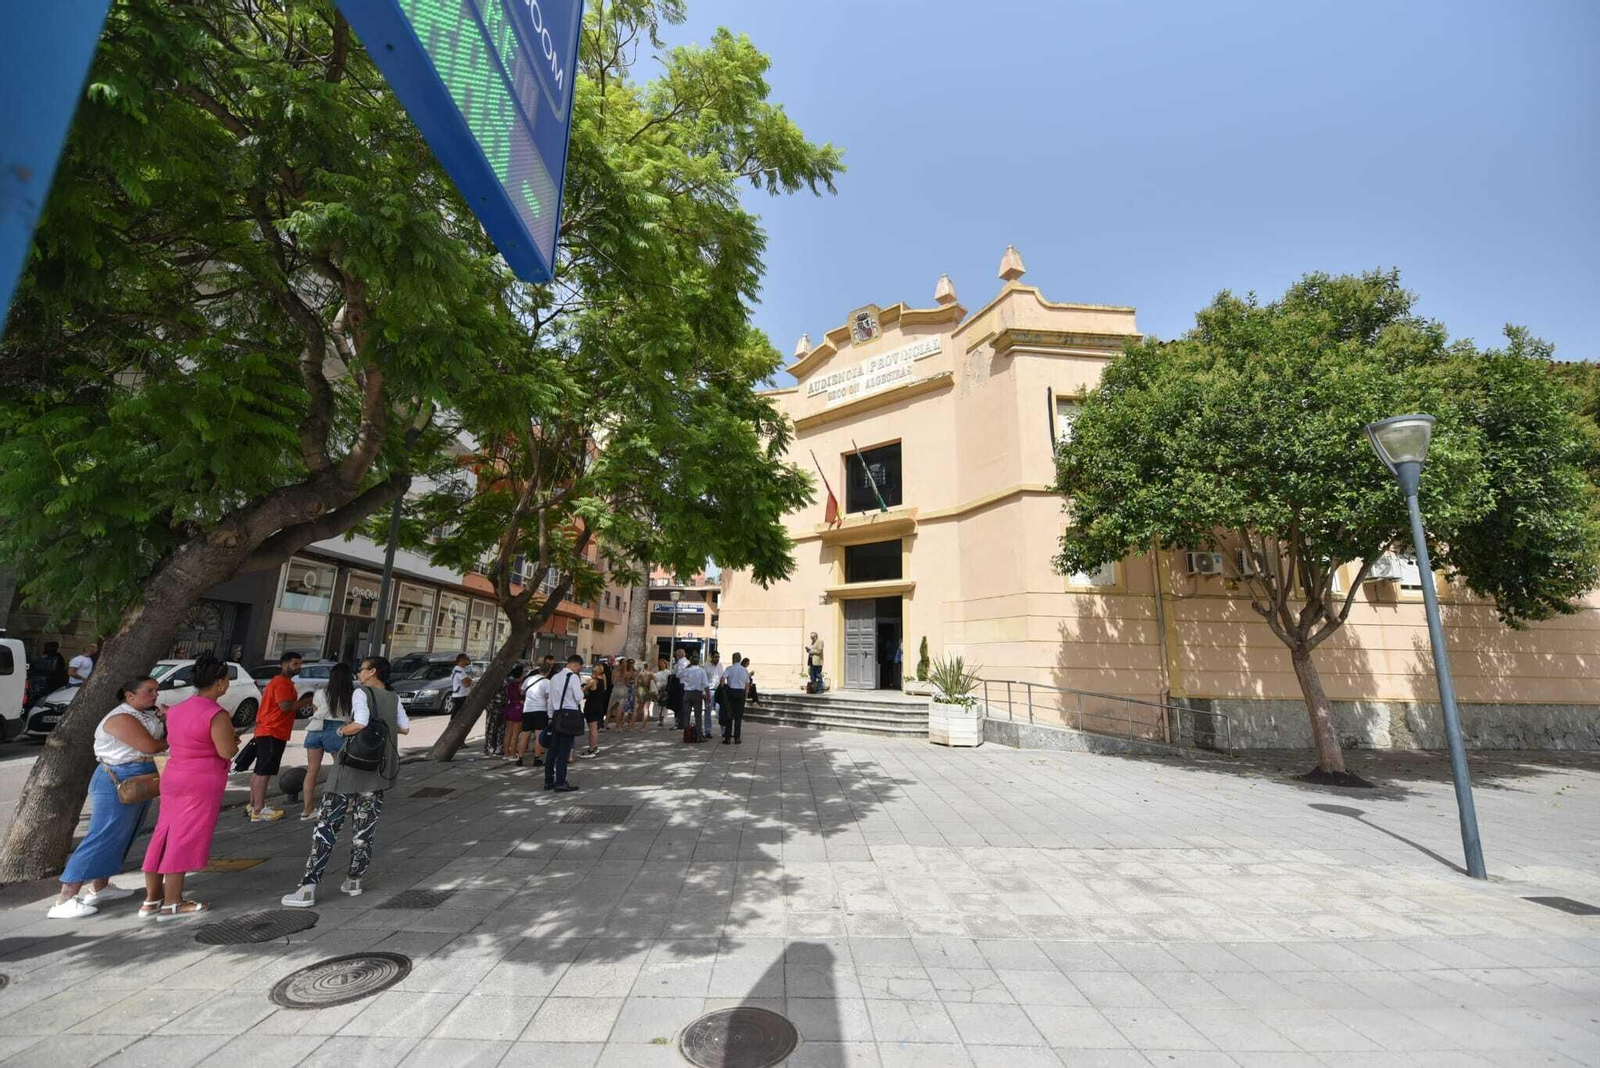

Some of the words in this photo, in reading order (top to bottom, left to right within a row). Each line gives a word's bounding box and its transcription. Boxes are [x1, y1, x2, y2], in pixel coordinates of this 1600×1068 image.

[526, 0, 563, 90] OOM
[808, 365, 864, 394] AUDIENCIA
[869, 338, 941, 372] PROVINCIAL
